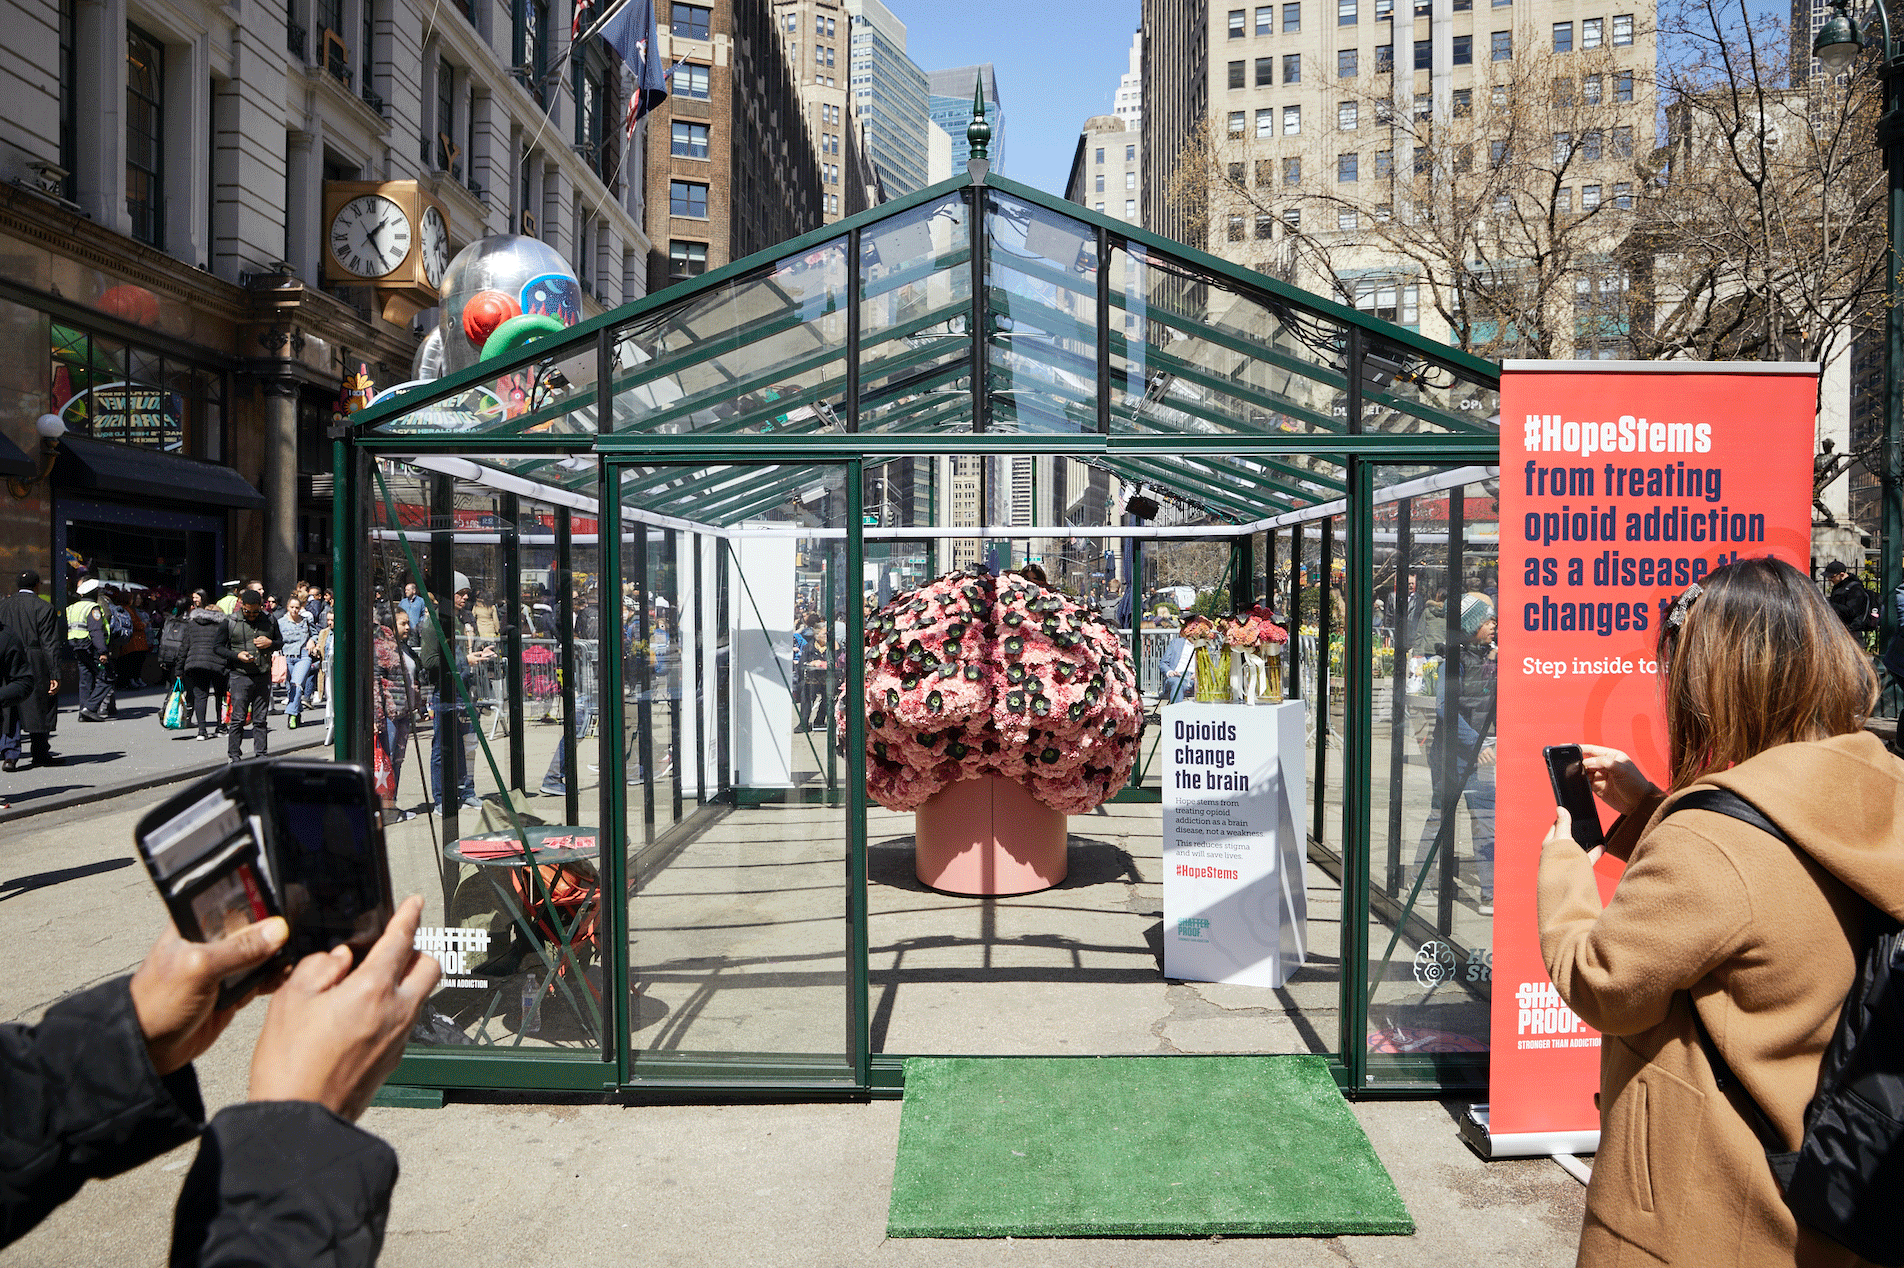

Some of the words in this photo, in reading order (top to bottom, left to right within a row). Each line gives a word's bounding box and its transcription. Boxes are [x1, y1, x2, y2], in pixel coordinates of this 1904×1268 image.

[1524, 415, 1712, 457] #HopeStems
[1525, 460, 1594, 496] from
[1604, 461, 1722, 503] treating
[1525, 506, 1616, 546] opioid
[1626, 506, 1765, 542] addiction
[1524, 557, 1558, 586] as
[1568, 557, 1583, 586] a
[1594, 551, 1707, 587] disease
[1524, 595, 1648, 637] changes
[1523, 657, 1567, 678] Step
[1572, 657, 1633, 674] inside
[1638, 658, 1658, 674] to
[1175, 720, 1236, 742] Opioids
[1175, 745, 1235, 768] change
[1175, 769, 1201, 789] the
[1207, 770, 1249, 791] brain
[1175, 797, 1195, 806] Hope
[1220, 799, 1239, 807] from
[1175, 808, 1204, 816] treating
[1206, 809, 1231, 817] opioid
[1175, 817, 1211, 825] addiction
[1227, 819, 1248, 827] brain
[1175, 826, 1204, 835] disease,
[1176, 839, 1192, 847] This
[1193, 840, 1223, 849] reduces
[1225, 842, 1251, 851] stigma
[1224, 851, 1243, 859] lives.
[1176, 864, 1238, 880] #HopeStems
[413, 927, 491, 951] SHATTER
[421, 951, 471, 975] OOF.
[457, 979, 488, 988] ADDICTION
[1518, 1040, 1551, 1050] STRONGER
[1552, 1039, 1569, 1048] THAN
